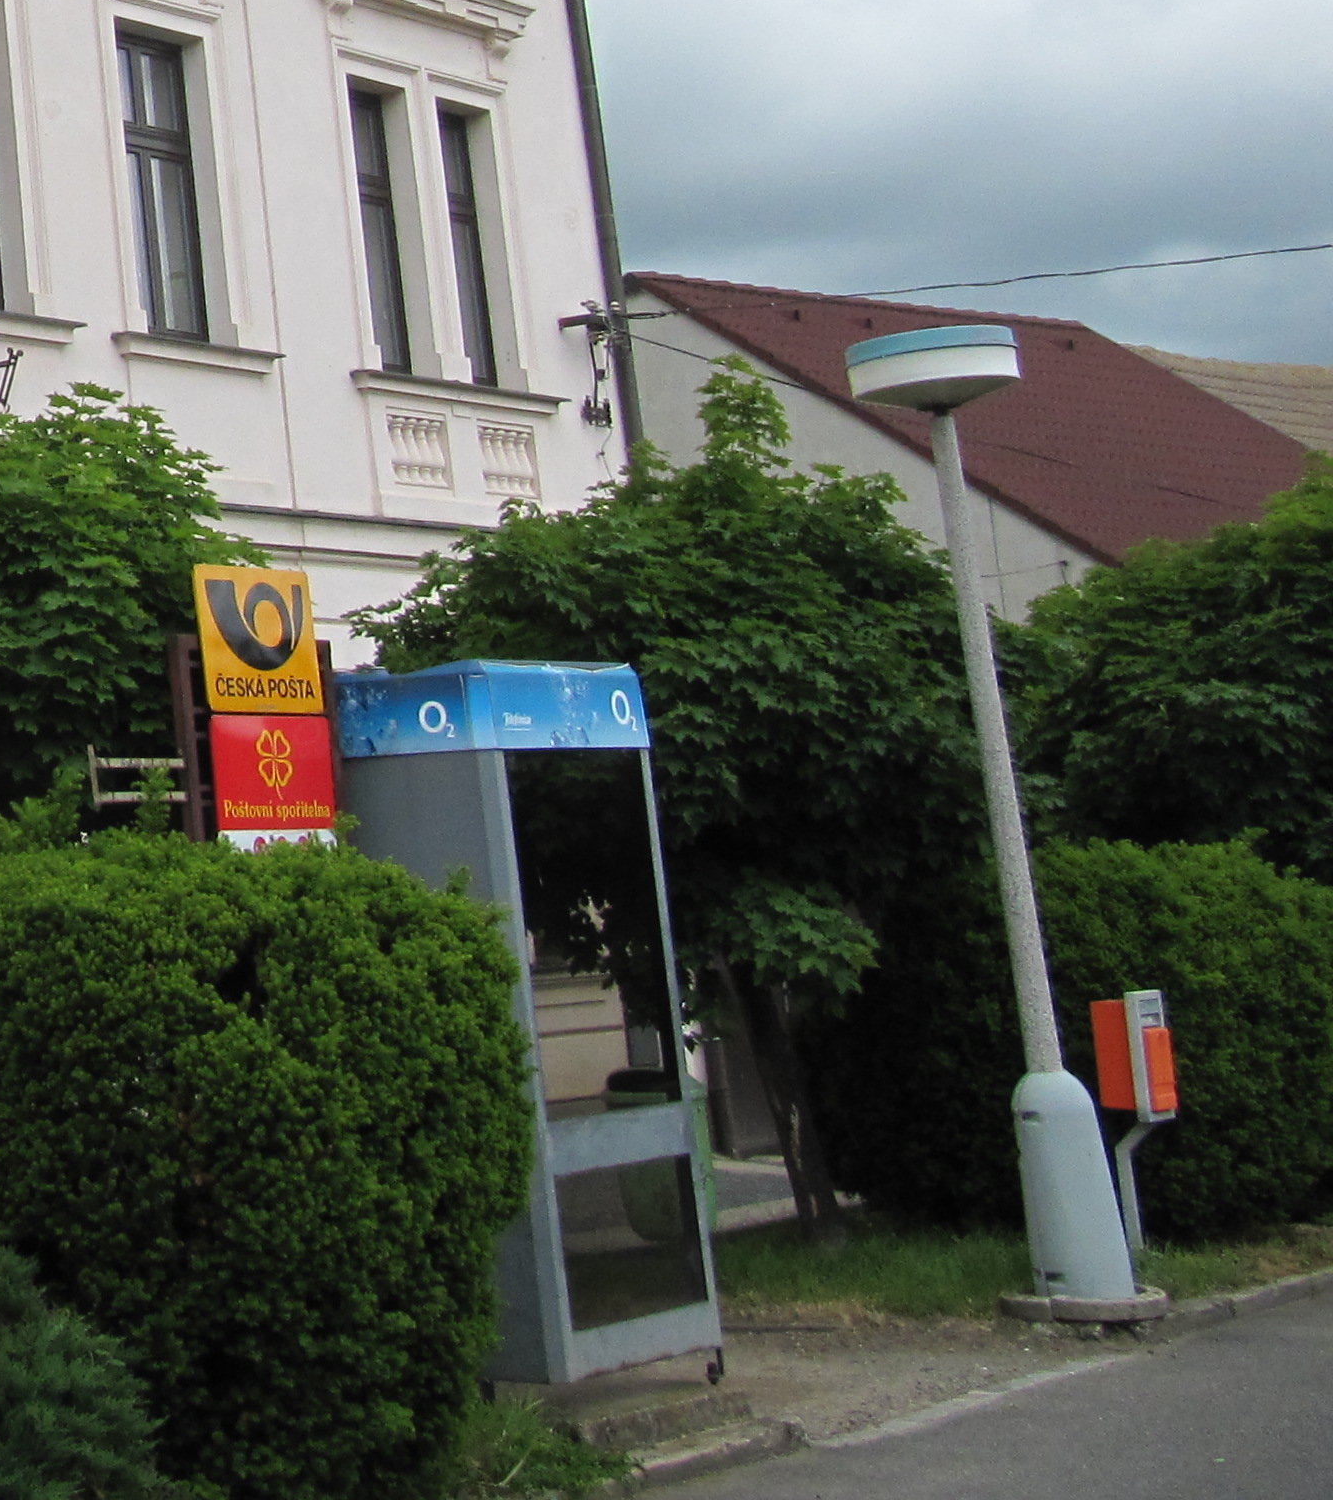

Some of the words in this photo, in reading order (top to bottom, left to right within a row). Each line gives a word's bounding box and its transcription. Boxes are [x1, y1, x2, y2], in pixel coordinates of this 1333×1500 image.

[215, 673, 266, 698] ČESKÁ
[268, 675, 316, 699] POŠTA
[418, 700, 456, 738] O2
[611, 689, 638, 731] O2
[223, 799, 274, 818] Poštovní
[276, 799, 331, 822] spořitelna
